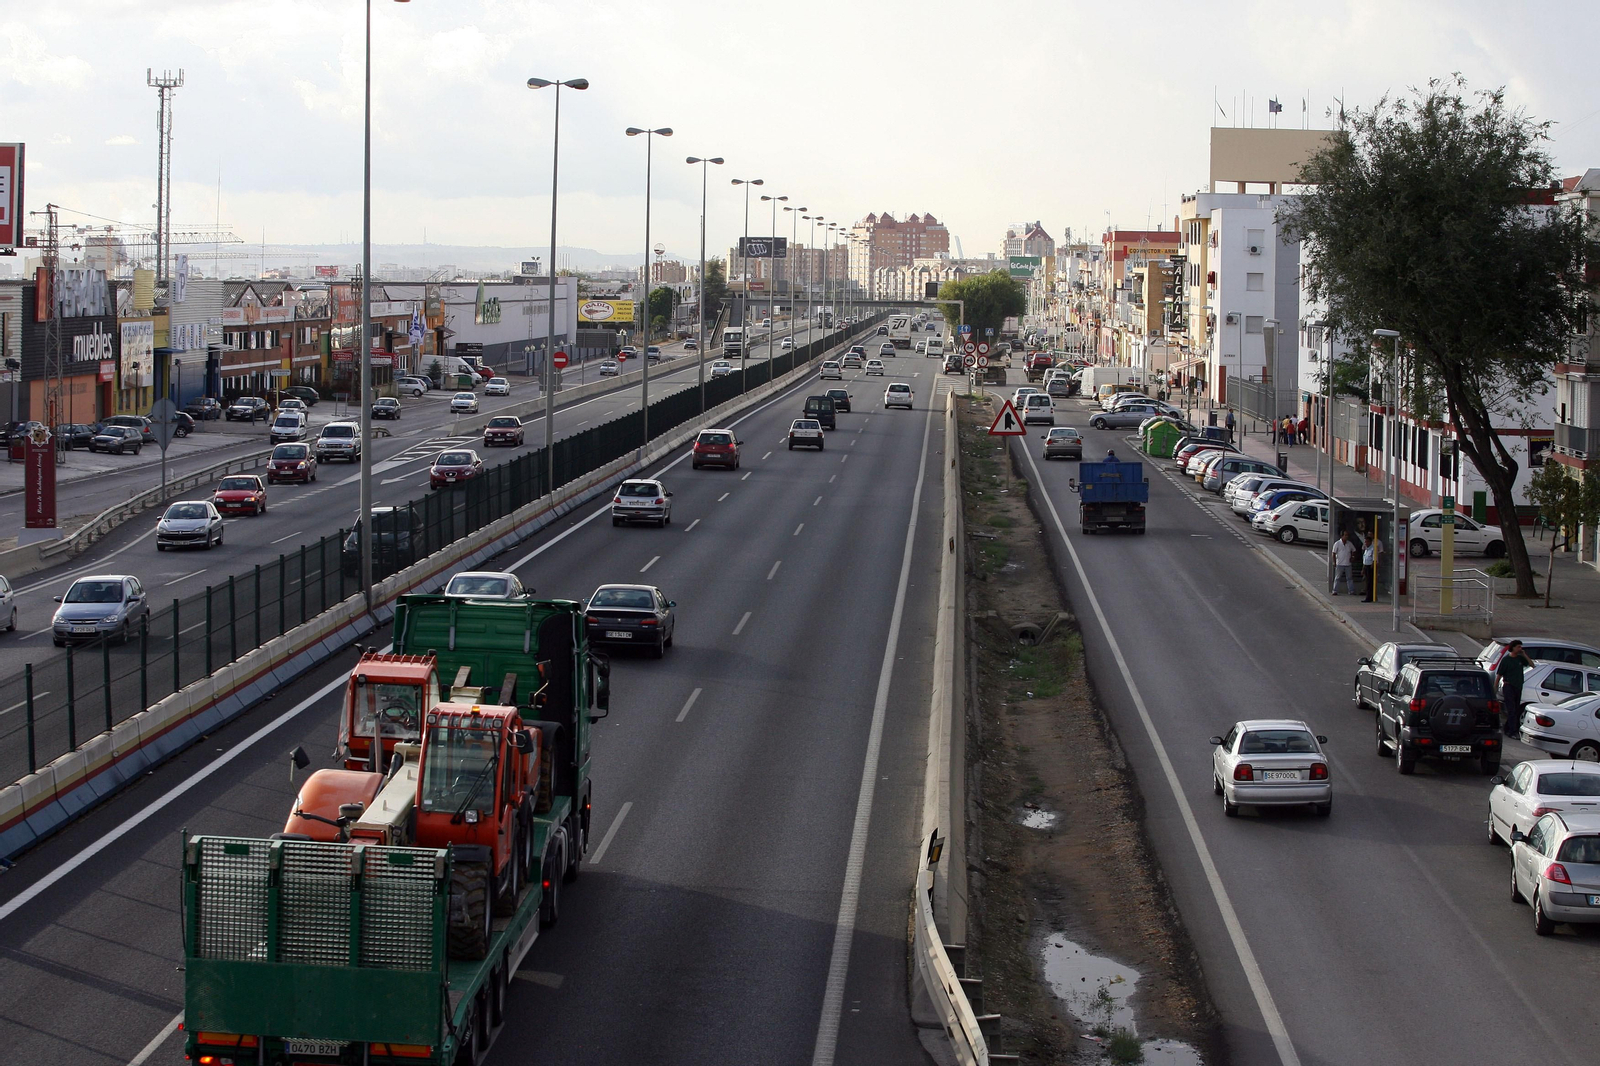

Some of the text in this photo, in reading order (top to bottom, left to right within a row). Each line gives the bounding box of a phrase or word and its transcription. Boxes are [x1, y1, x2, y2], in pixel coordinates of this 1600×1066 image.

[1174, 266, 1182, 324] ALCALA
[73, 321, 113, 361] muebles
[292, 1044, 337, 1054] 0470 BZH
